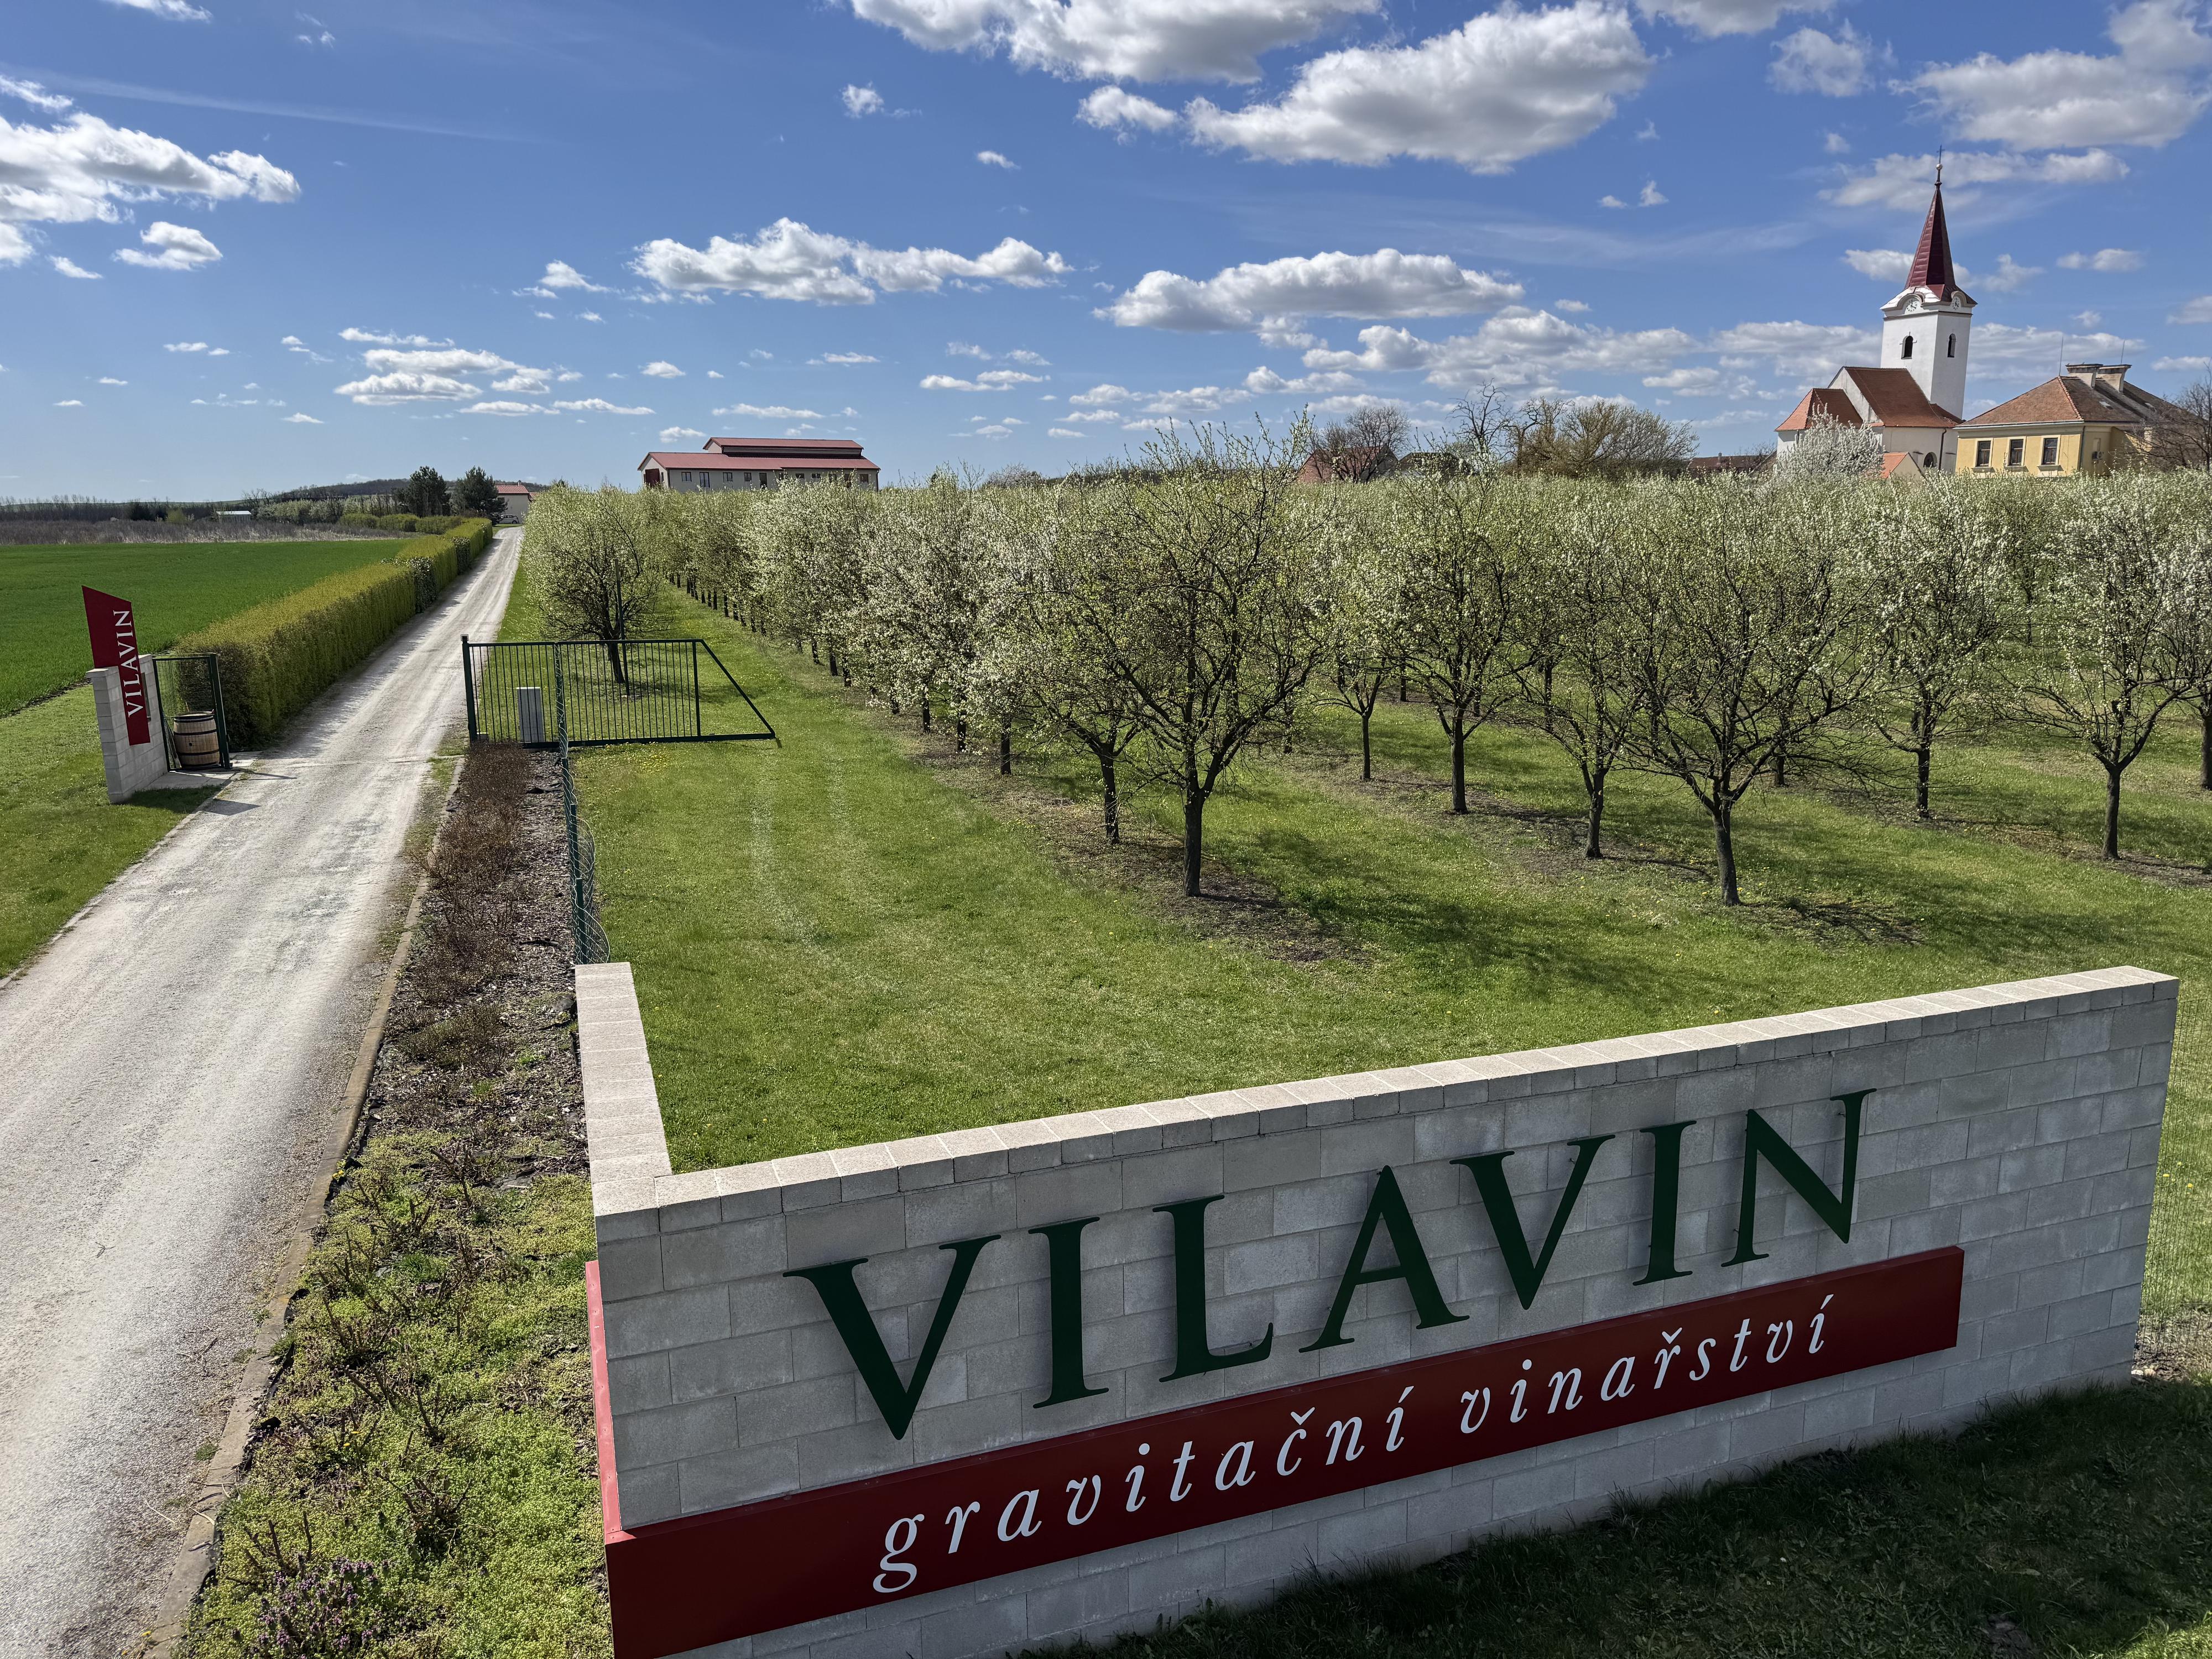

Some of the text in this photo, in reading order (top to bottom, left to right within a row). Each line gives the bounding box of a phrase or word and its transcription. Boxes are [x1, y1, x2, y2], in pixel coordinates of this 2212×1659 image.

[113, 610, 144, 718] VILAVIN
[782, 1088, 1877, 1440] VILAVIN
[872, 1294, 1834, 1593] gravitační vinařství
